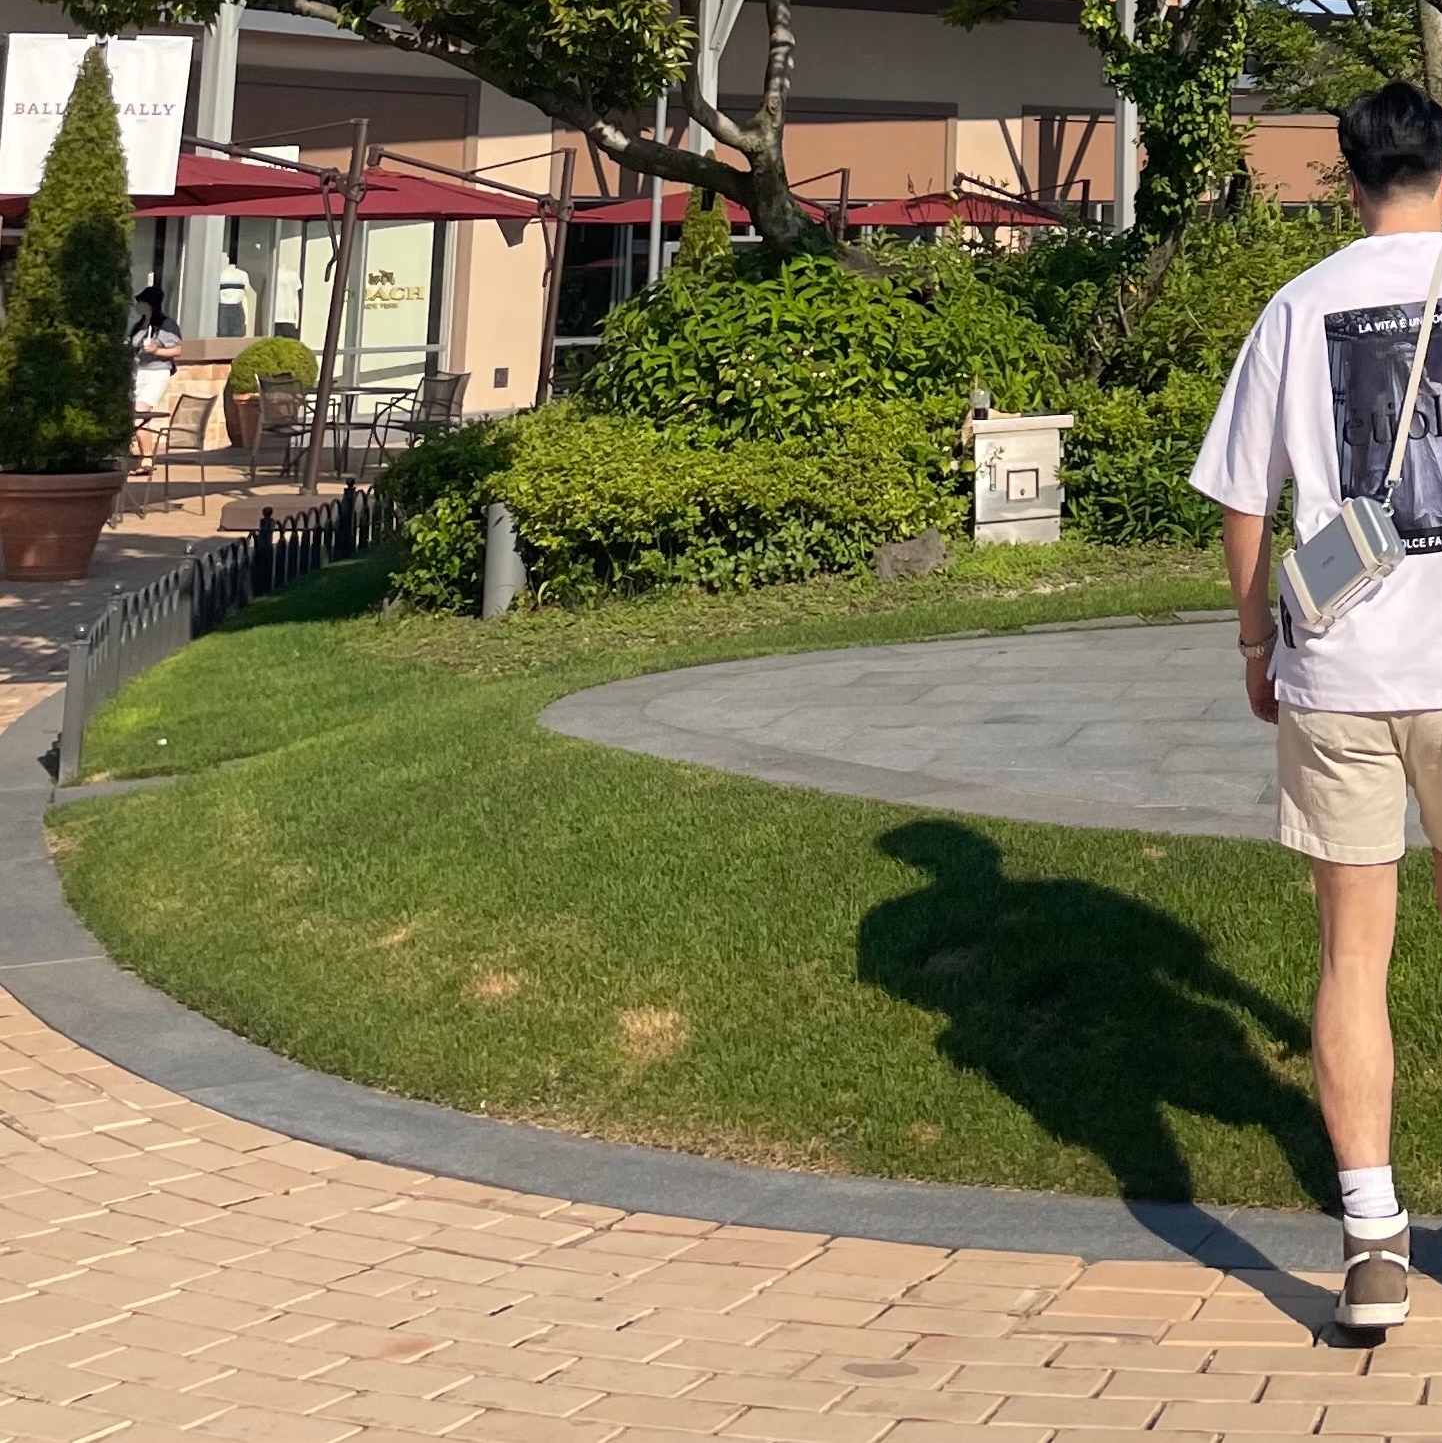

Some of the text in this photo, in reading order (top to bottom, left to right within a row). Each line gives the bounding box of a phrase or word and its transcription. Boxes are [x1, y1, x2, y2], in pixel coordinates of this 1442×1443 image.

[14, 102, 66, 115] BALL
[1358, 322, 1373, 333] LA
[1374, 319, 1398, 331] VITA
